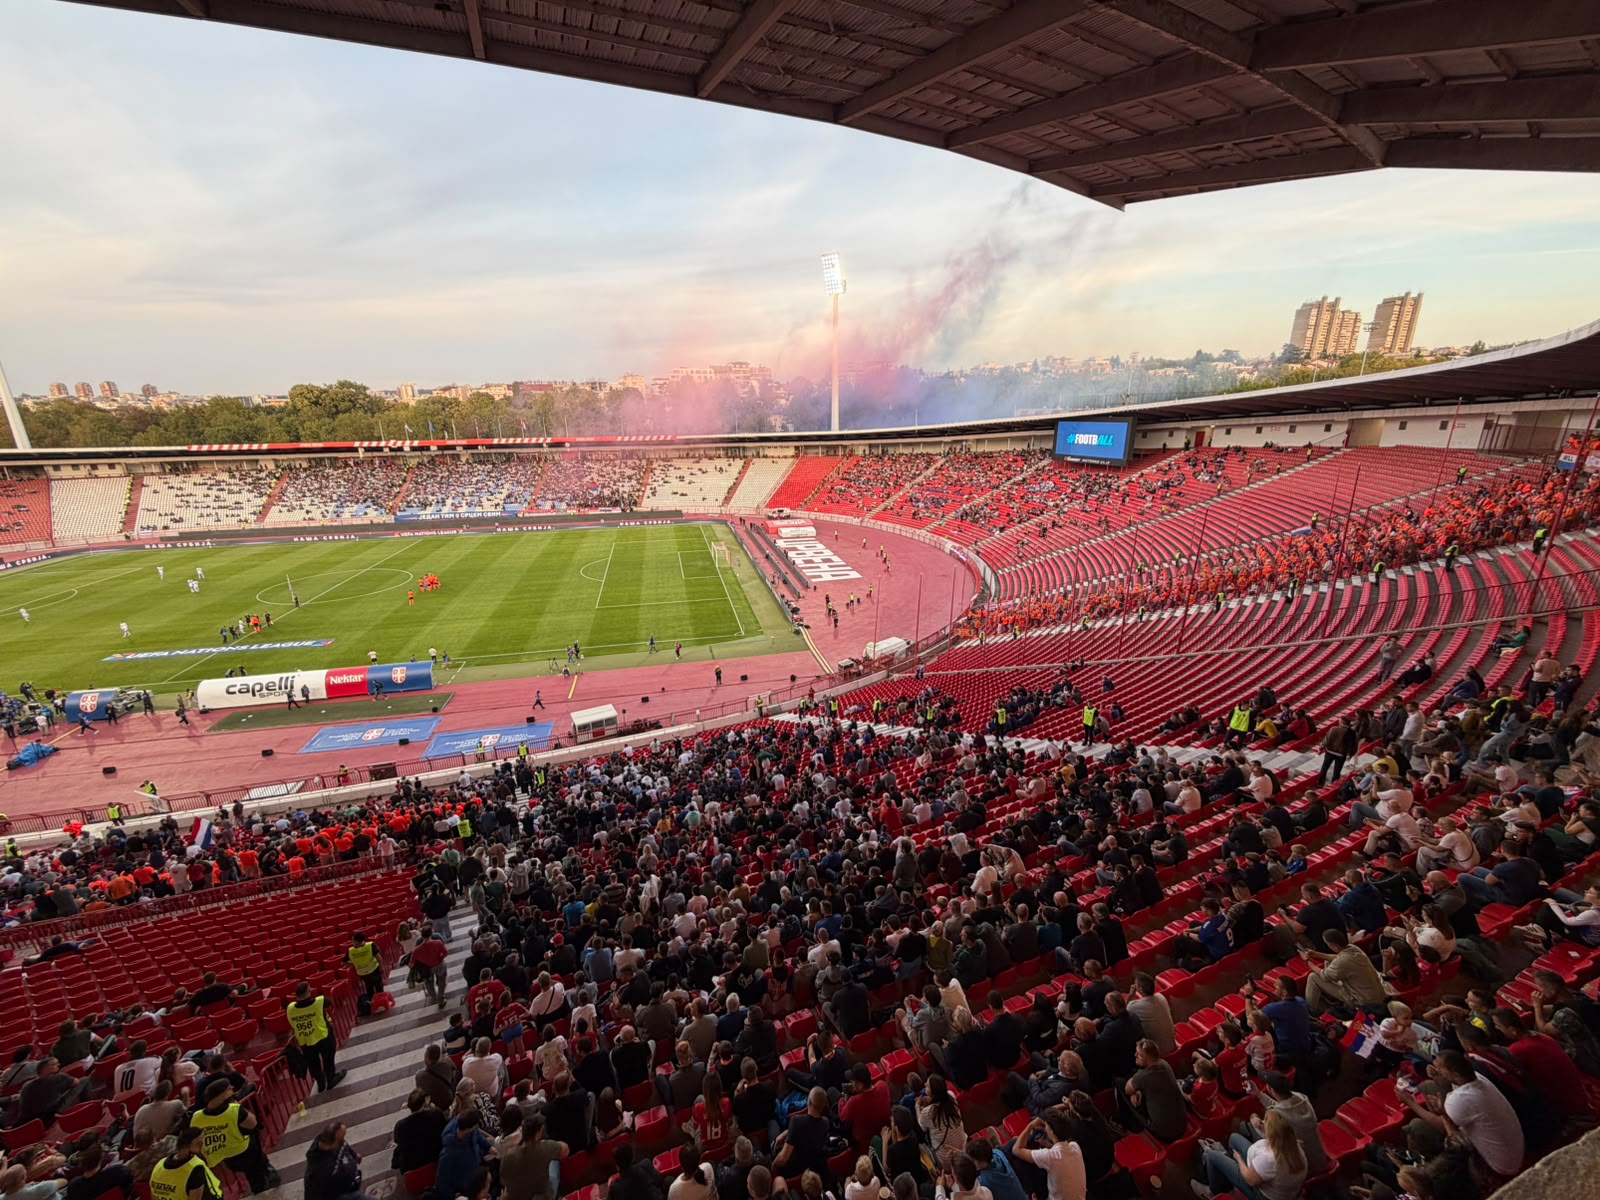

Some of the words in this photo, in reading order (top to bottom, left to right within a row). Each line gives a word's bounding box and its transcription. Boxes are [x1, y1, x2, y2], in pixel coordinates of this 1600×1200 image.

[1067, 433, 1114, 446] #FOOTBALL
[171, 644, 249, 656] NATIONS
[249, 640, 317, 650] LEAGUE
[225, 675, 296, 697] capelli
[329, 673, 364, 685] Nektar
[258, 690, 289, 699] SPOR
[120, 1069, 136, 1093] 10
